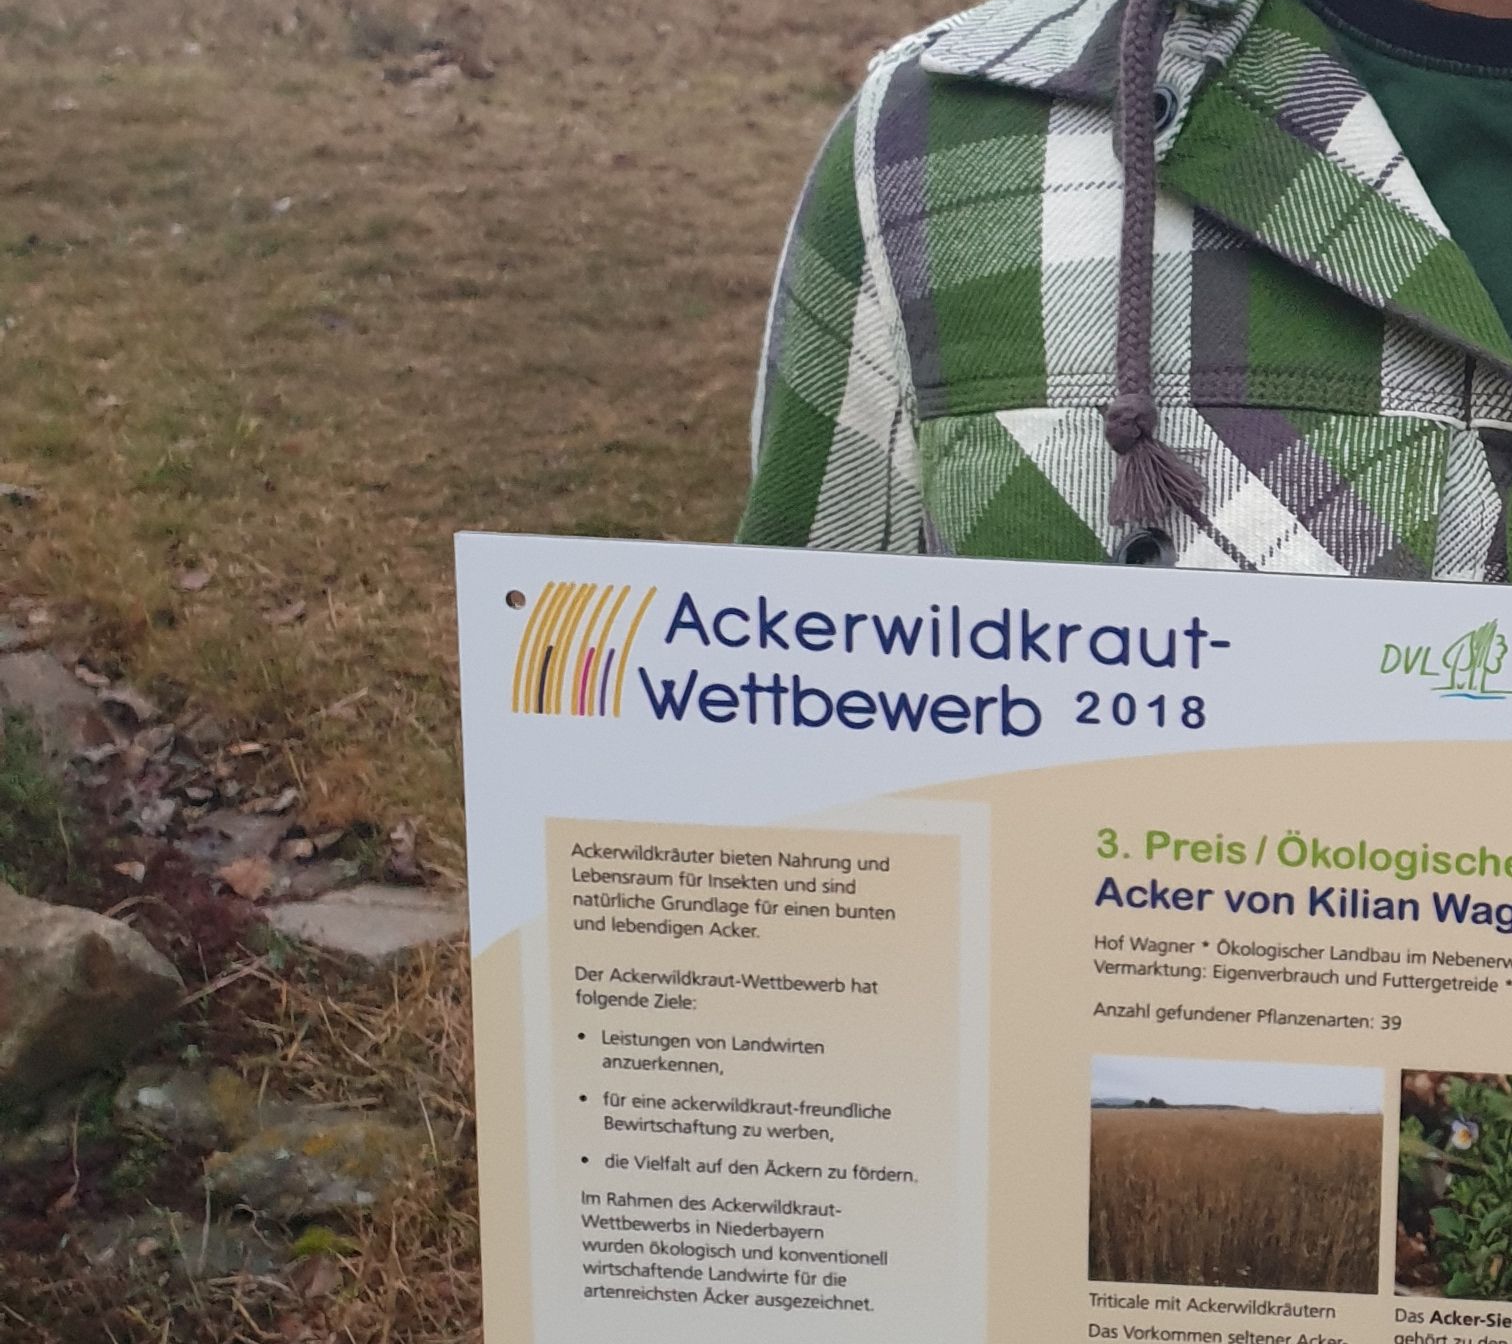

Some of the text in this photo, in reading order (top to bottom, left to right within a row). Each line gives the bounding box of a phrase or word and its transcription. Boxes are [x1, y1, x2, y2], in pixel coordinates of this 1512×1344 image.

[664, 591, 1231, 671] Ackerwildkraut-
[1379, 643, 1441, 676] DVL
[638, 666, 1206, 738] Wettbewerb 2018
[571, 842, 891, 875] Ackerwildkräuter bieten Nahrung und
[1096, 827, 1131, 860] 3.
[1145, 829, 1248, 866] Preis
[571, 867, 857, 896] Lebensraum für Insekten und sind
[572, 892, 897, 922] natürliche Grundlage für einen bunten
[1094, 876, 1215, 912] Acker
[1224, 889, 1295, 917] von
[1309, 885, 1420, 922] Kilian
[573, 915, 761, 939] und lebendigen Acker.
[1094, 934, 1126, 952] Hof
[1129, 936, 1196, 956] Wagner
[1216, 938, 1326, 962] Ökologischer
[1329, 945, 1402, 965] Landbau
[1406, 949, 1427, 965] im
[574, 965, 879, 995] Der Ackerwildkraut-Wettbewerb hat
[1093, 958, 1207, 983] Vermarktung:
[1213, 964, 1340, 985] Eigenverbrauch
[1345, 971, 1378, 988] und
[1382, 972, 1500, 995] Futtergetreide
[575, 988, 697, 1011] folgende Ziele:
[1092, 1002, 1403, 1032] Anzahl gefundener Pflanzenarten: 39
[601, 1029, 826, 1055] Leistungen von Landwirten
[602, 1055, 725, 1076] anzuerkennen,
[1088, 1292, 1337, 1319] Triticale mit Ackerwildkräutern
[1395, 1307, 1425, 1325] Das
[1088, 1323, 1119, 1340] Das
[1122, 1324, 1223, 1344] Vorkommen
